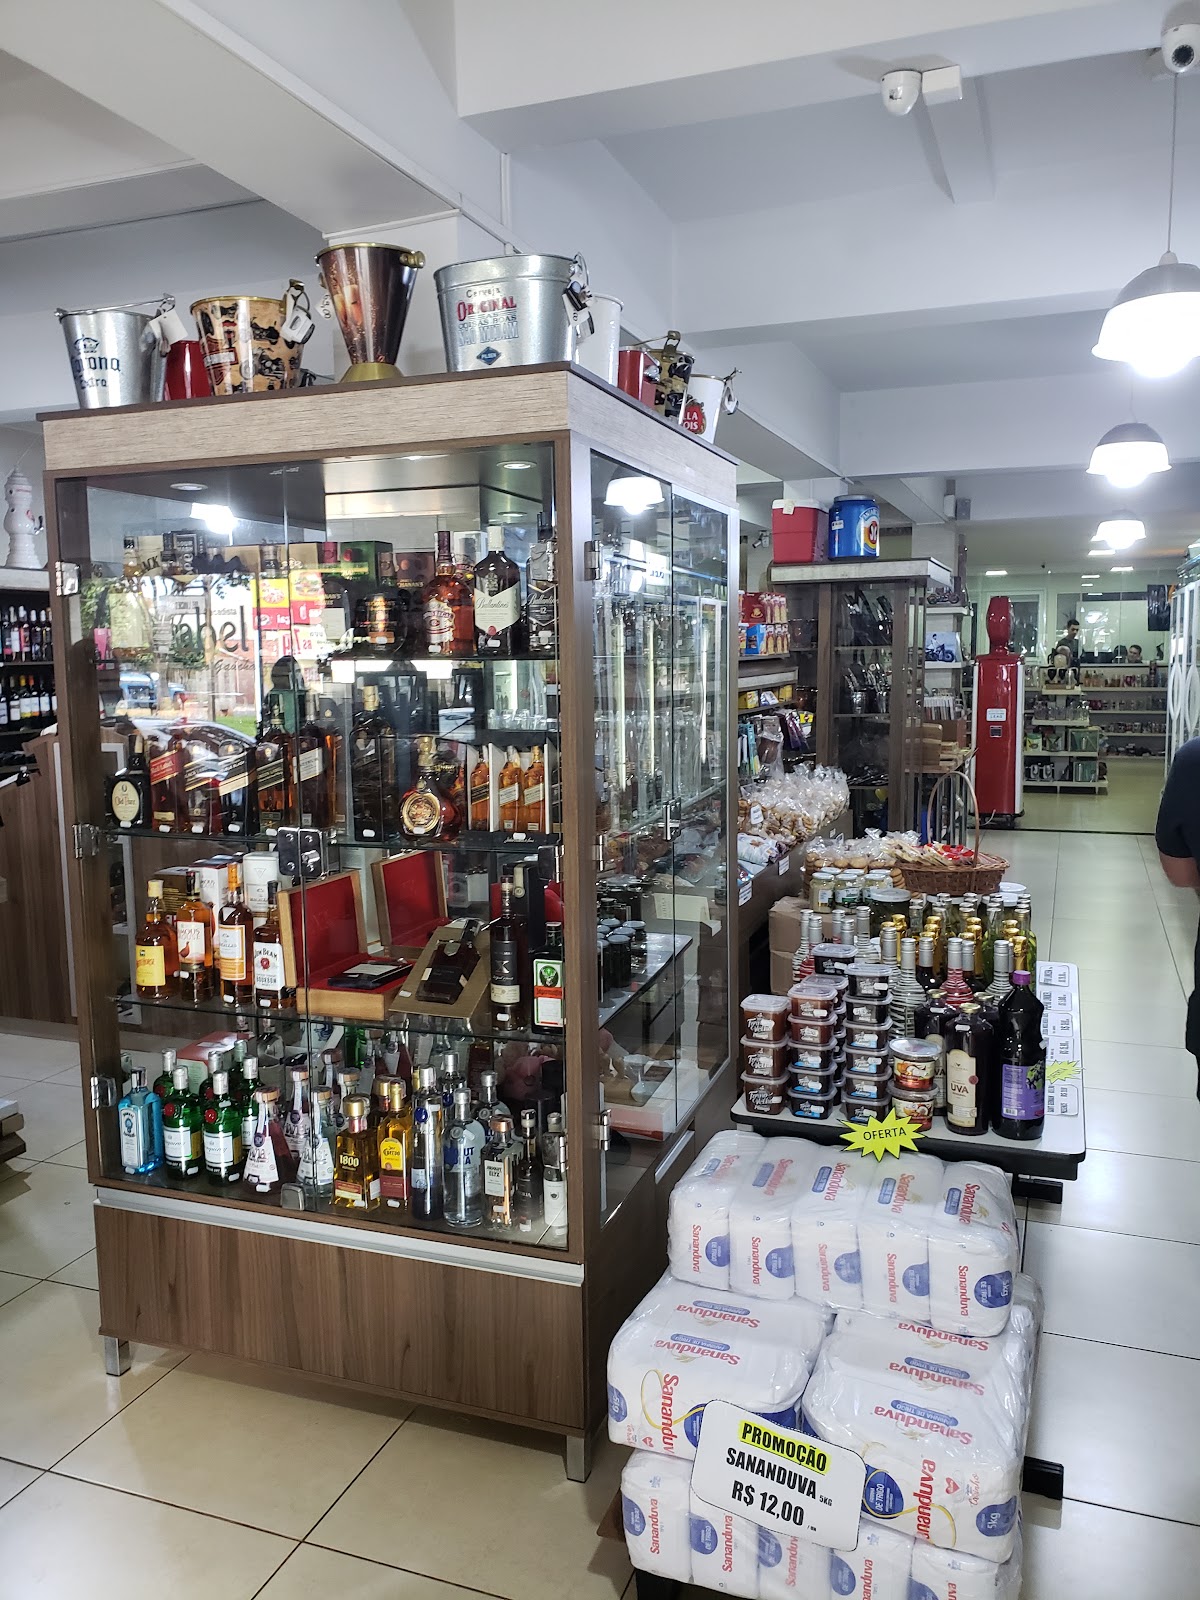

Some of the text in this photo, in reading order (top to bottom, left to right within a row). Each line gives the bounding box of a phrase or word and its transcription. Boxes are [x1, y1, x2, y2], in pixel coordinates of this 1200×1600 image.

[466, 286, 501, 298] Cerveja
[950, 1083, 969, 1094] UVA
[863, 1127, 907, 1141] OFERTA
[339, 1154, 360, 1168] 1800
[824, 1162, 848, 1201] Sananduva
[959, 1183, 981, 1225] Sananduva
[692, 1225, 702, 1272] Sananduva
[752, 1237, 763, 1285] Sananduva
[818, 1243, 830, 1292] Sananduva
[886, 1253, 898, 1303] Sananduva
[958, 1265, 970, 1317] Sananduva
[676, 1304, 761, 1329] Sananduva
[899, 1322, 989, 1351] Sananduva
[655, 1339, 741, 1366] Sananduva
[889, 1362, 985, 1396] Sananduva
[661, 1373, 680, 1454] Sananduv
[874, 1405, 973, 1446] Sananduva
[896, 1403, 915, 1414] TRIGO
[916, 1410, 925, 1418] DE
[741, 1422, 828, 1472] PROMOÇÃO
[726, 1447, 833, 1507] SANANDUVA 5KG
[731, 1480, 756, 1507] R$
[759, 1491, 805, 1526] 12,00
[875, 1483, 885, 1512] DE TRIGO
[648, 1498, 660, 1555] Sananduva
[987, 1512, 1001, 1529] 5kg
[722, 1515, 734, 1572] Sananduva
